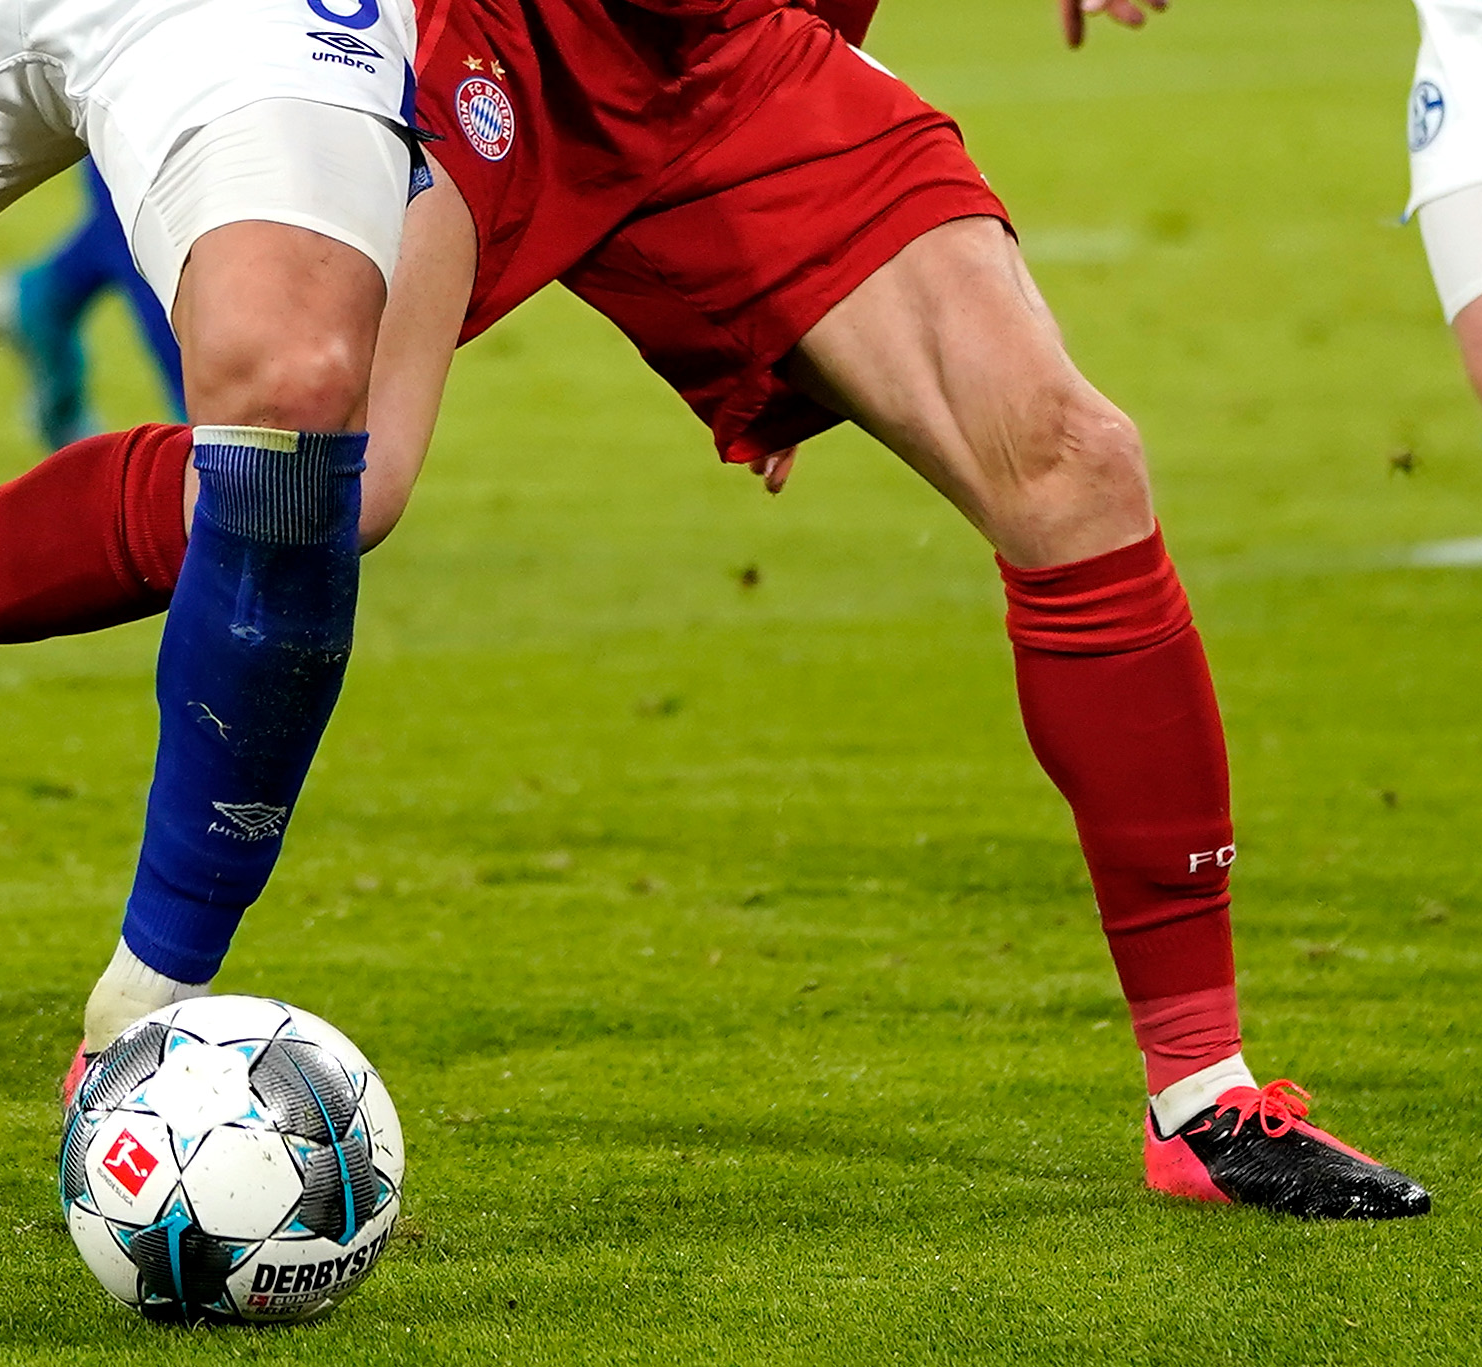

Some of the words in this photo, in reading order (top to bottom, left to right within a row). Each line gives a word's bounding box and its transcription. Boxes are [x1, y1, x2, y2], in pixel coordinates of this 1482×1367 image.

[312, 51, 376, 75] umbro
[467, 82, 482, 95] FC
[484, 85, 511, 141] BAYERN
